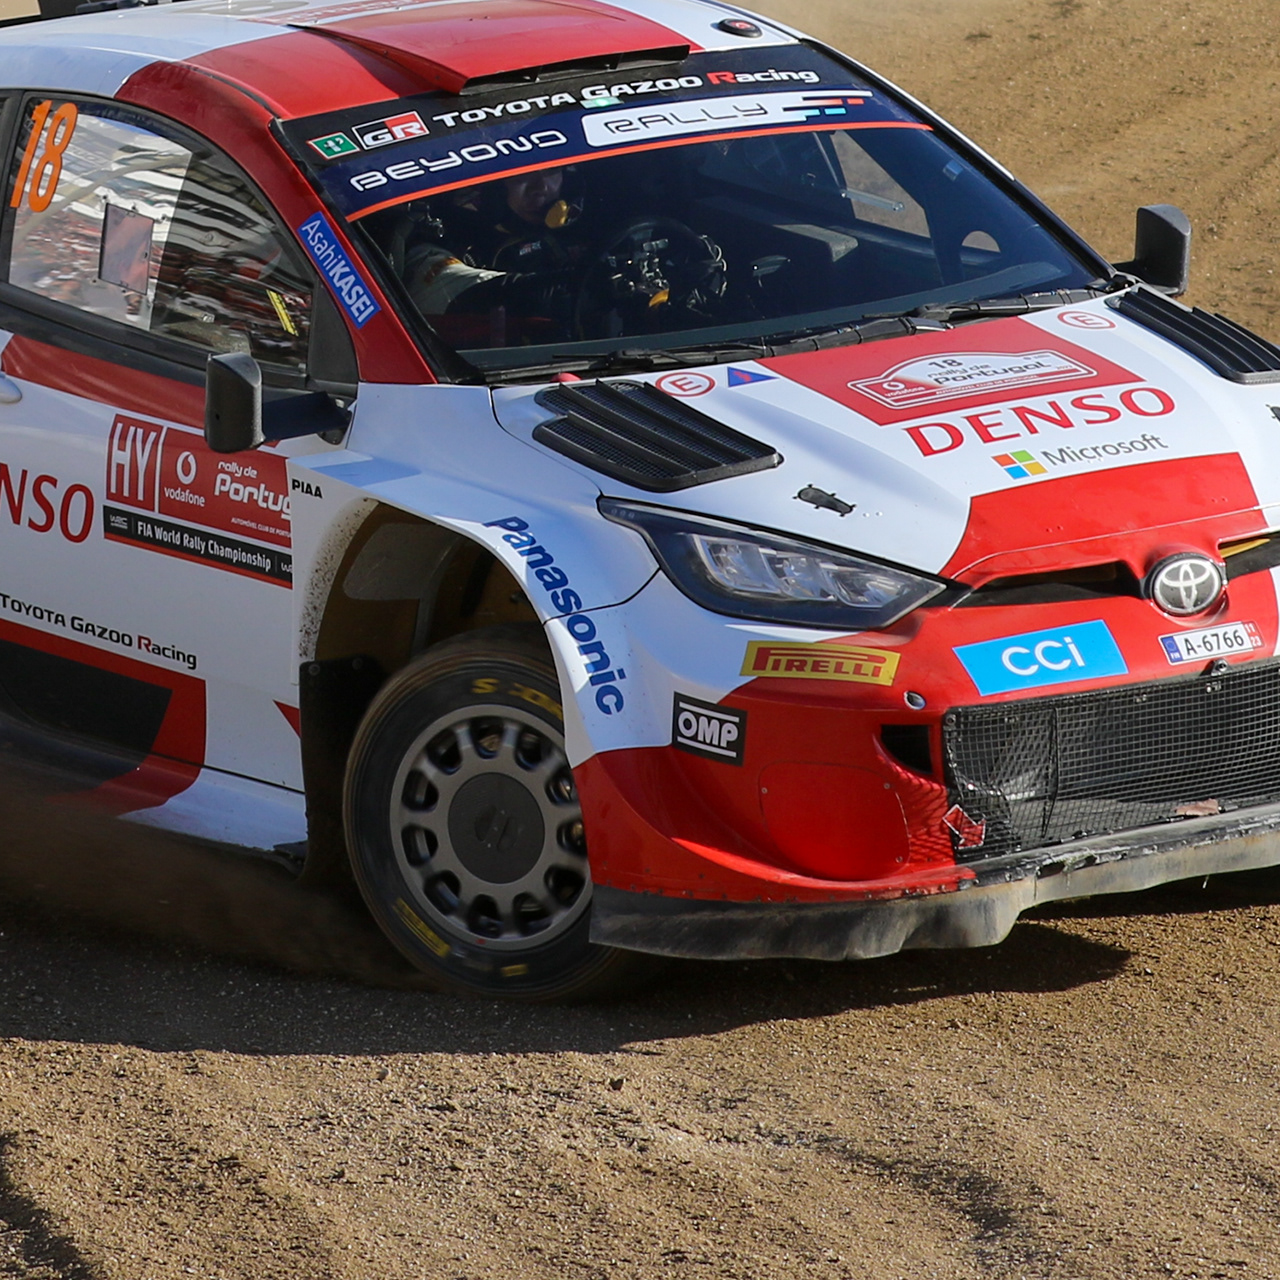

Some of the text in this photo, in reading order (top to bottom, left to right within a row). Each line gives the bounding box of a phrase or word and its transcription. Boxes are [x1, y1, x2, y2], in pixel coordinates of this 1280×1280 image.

[362, 69, 820, 148] GR TOYOTA GAZOO Racing
[604, 102, 768, 134] RALLY
[10, 99, 78, 213] 18
[350, 130, 568, 191] BEYOND
[927, 368, 968, 378] rally
[928, 359, 963, 369] 18
[934, 361, 1052, 385] Portugal
[668, 376, 702, 393] E
[902, 387, 1176, 457] DENSO
[110, 423, 157, 501] HY
[1040, 433, 1169, 466] Microsoft
[217, 460, 258, 479] rally de
[164, 487, 205, 507] vodafone
[291, 478, 324, 499] PIAA
[137, 521, 271, 572] FIA World Rally Championship
[483, 516, 627, 715] Panasonic
[1244, 623, 1256, 633] 11
[70, 616, 133, 647] GAZOO
[137, 635, 197, 670] Racing
[1183, 629, 1244, 657] A-6766
[1250, 635, 1261, 647] 23
[752, 647, 887, 678] PIRELLI
[678, 710, 739, 748] OMP
